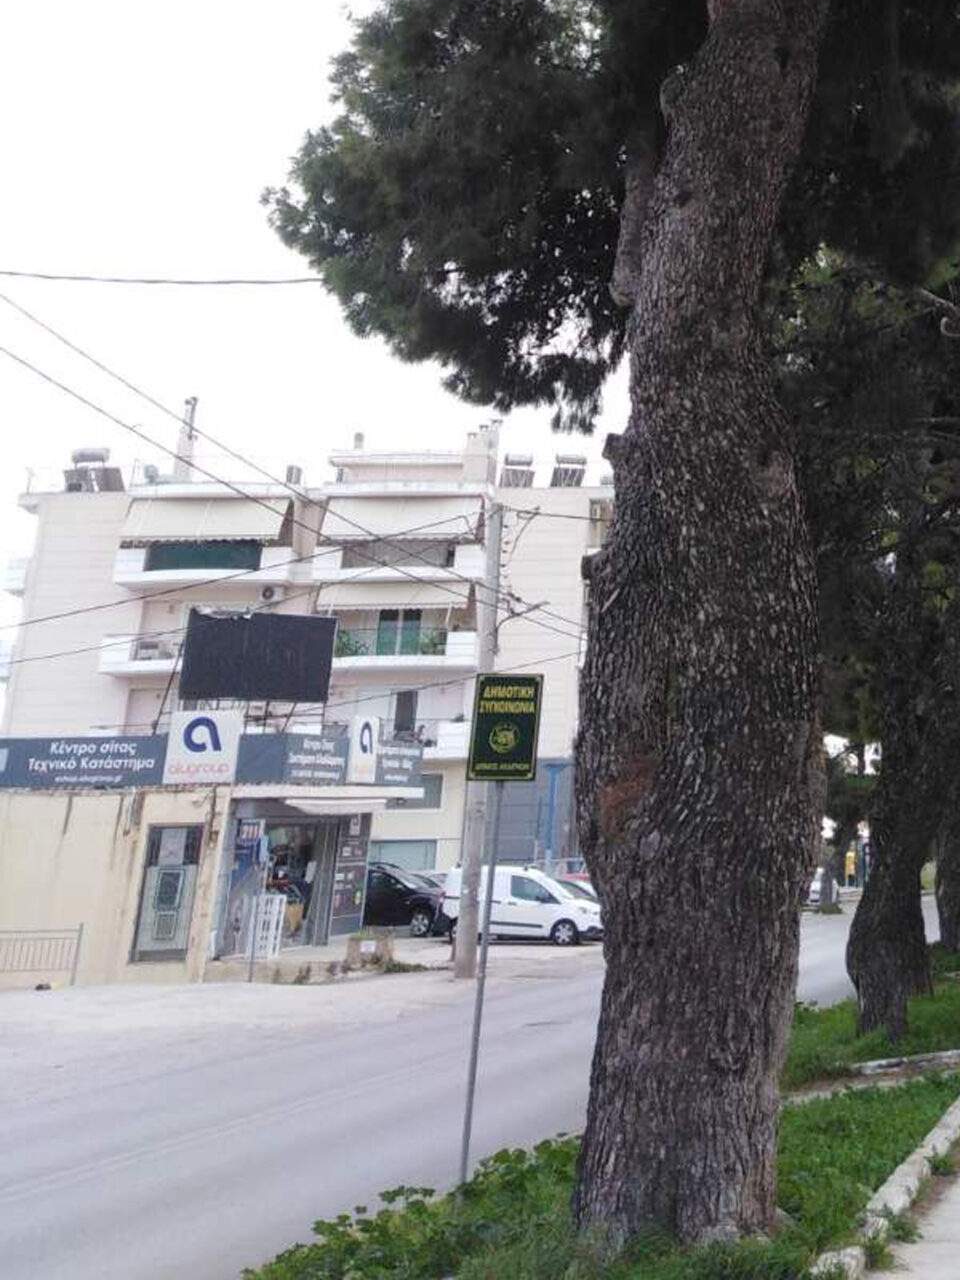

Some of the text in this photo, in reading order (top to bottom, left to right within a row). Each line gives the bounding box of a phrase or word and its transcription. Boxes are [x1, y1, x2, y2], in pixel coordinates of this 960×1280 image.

[483, 686, 535, 698] ΔΗΜΟΤΙΚΗ
[50, 740, 137, 755] Κέντρο σίτας
[28, 755, 155, 773] Τεχνικό Κατάστημα
